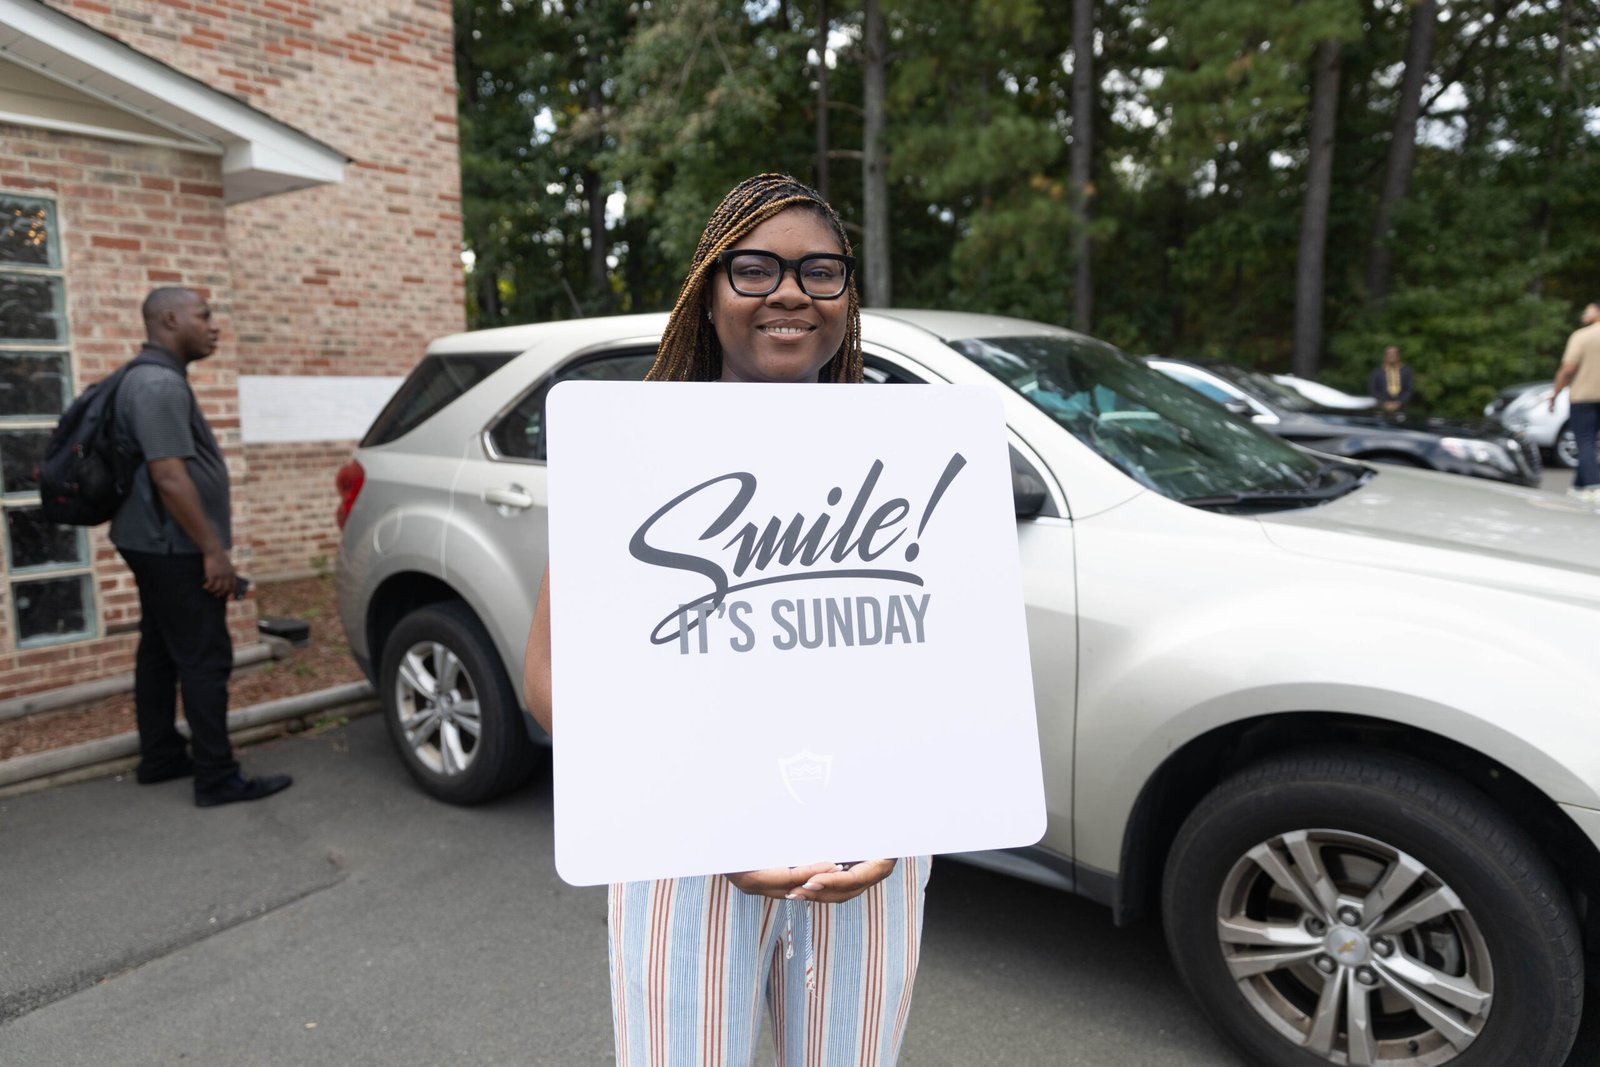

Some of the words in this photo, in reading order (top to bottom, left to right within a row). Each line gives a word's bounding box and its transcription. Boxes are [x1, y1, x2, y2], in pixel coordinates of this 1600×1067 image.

[628, 452, 967, 645] Smile!
[678, 600, 756, 655] IT'S
[771, 593, 931, 651] SUNDAY
